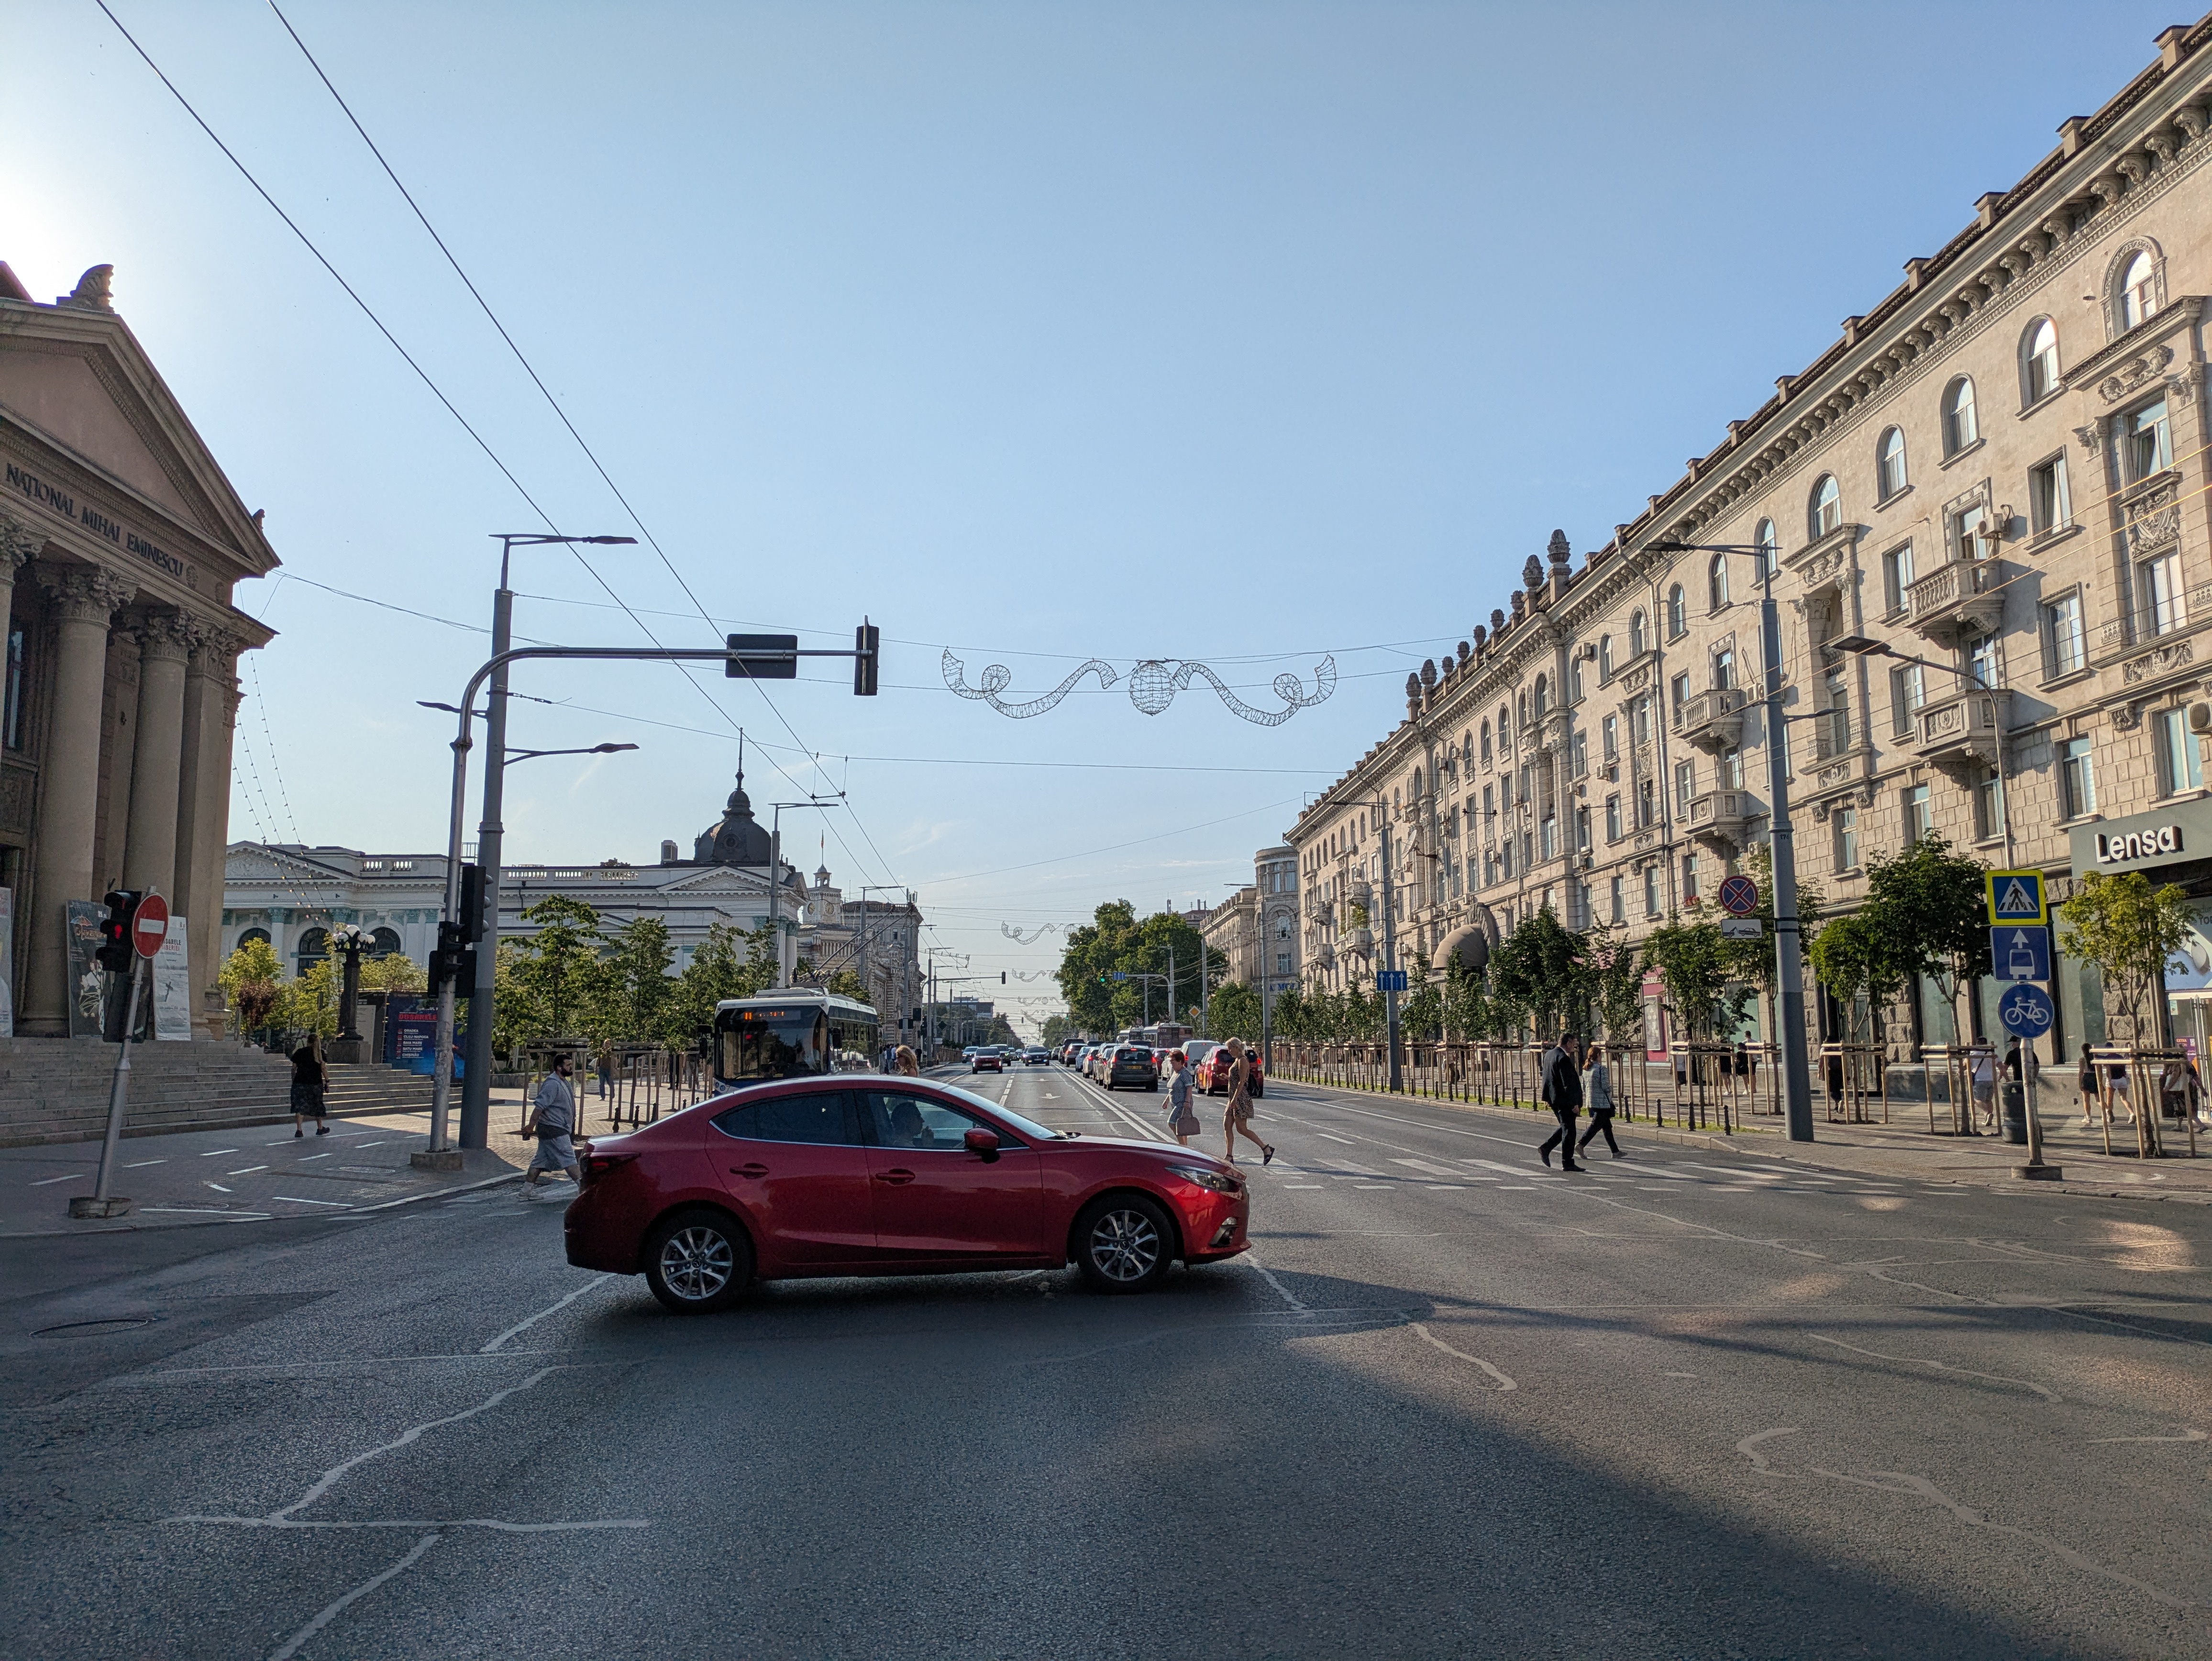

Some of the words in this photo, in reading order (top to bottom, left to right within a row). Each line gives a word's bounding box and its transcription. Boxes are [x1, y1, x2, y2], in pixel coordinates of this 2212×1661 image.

[81, 506, 120, 543] MIHAI
[126, 532, 184, 576] EMINESCU
[2094, 825, 2176, 863] Lensa
